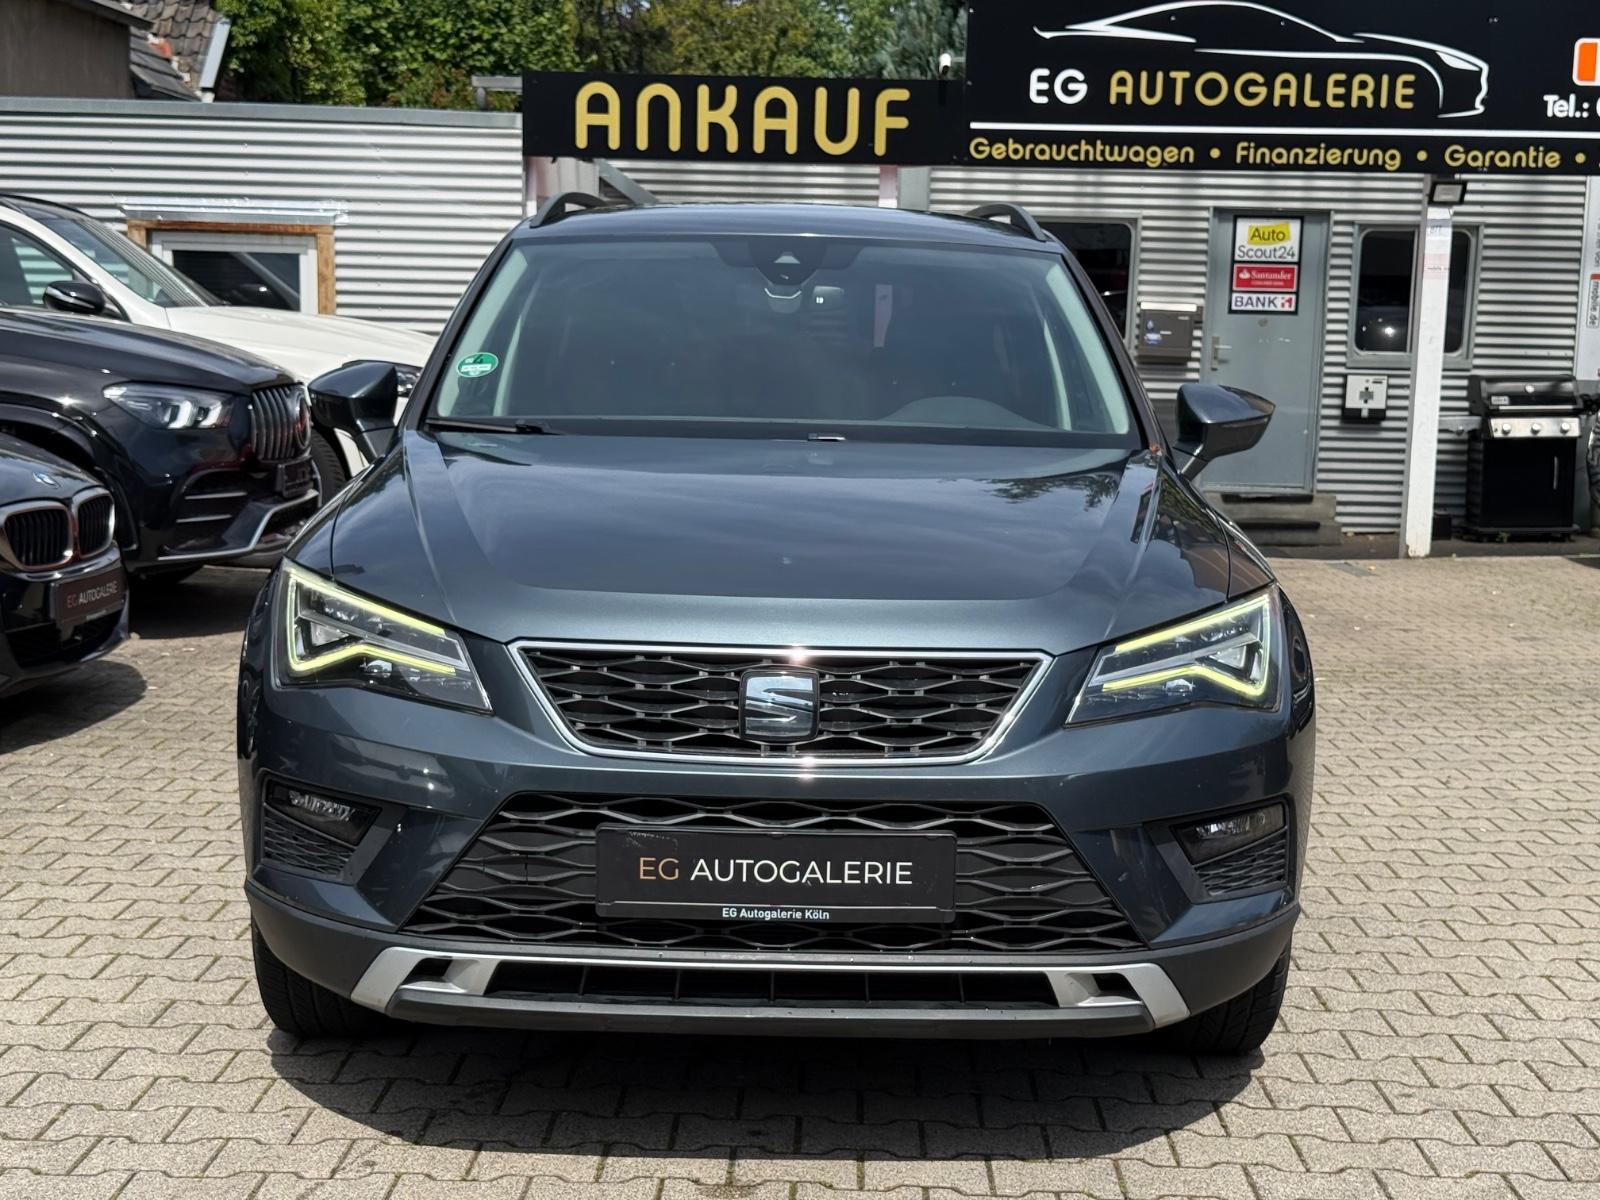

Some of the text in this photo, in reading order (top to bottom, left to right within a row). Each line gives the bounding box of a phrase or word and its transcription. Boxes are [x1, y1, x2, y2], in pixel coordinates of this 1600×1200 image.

[1029, 68, 1416, 110] EG AUTOGALERIE
[1543, 93, 1589, 118] Tel.:
[575, 81, 911, 157] ANKAUF
[969, 137, 1561, 171] Gebrauchtwagen Finanzierung Garantie
[1250, 227, 1286, 242] Auto
[1237, 245, 1296, 259] Scout24
[1251, 269, 1292, 280] Santander
[79, 581, 118, 605] AUTOGALERIE
[639, 857, 913, 885] EG AUTOGALERIE
[722, 907, 830, 920] EG Autogalerie Köln
